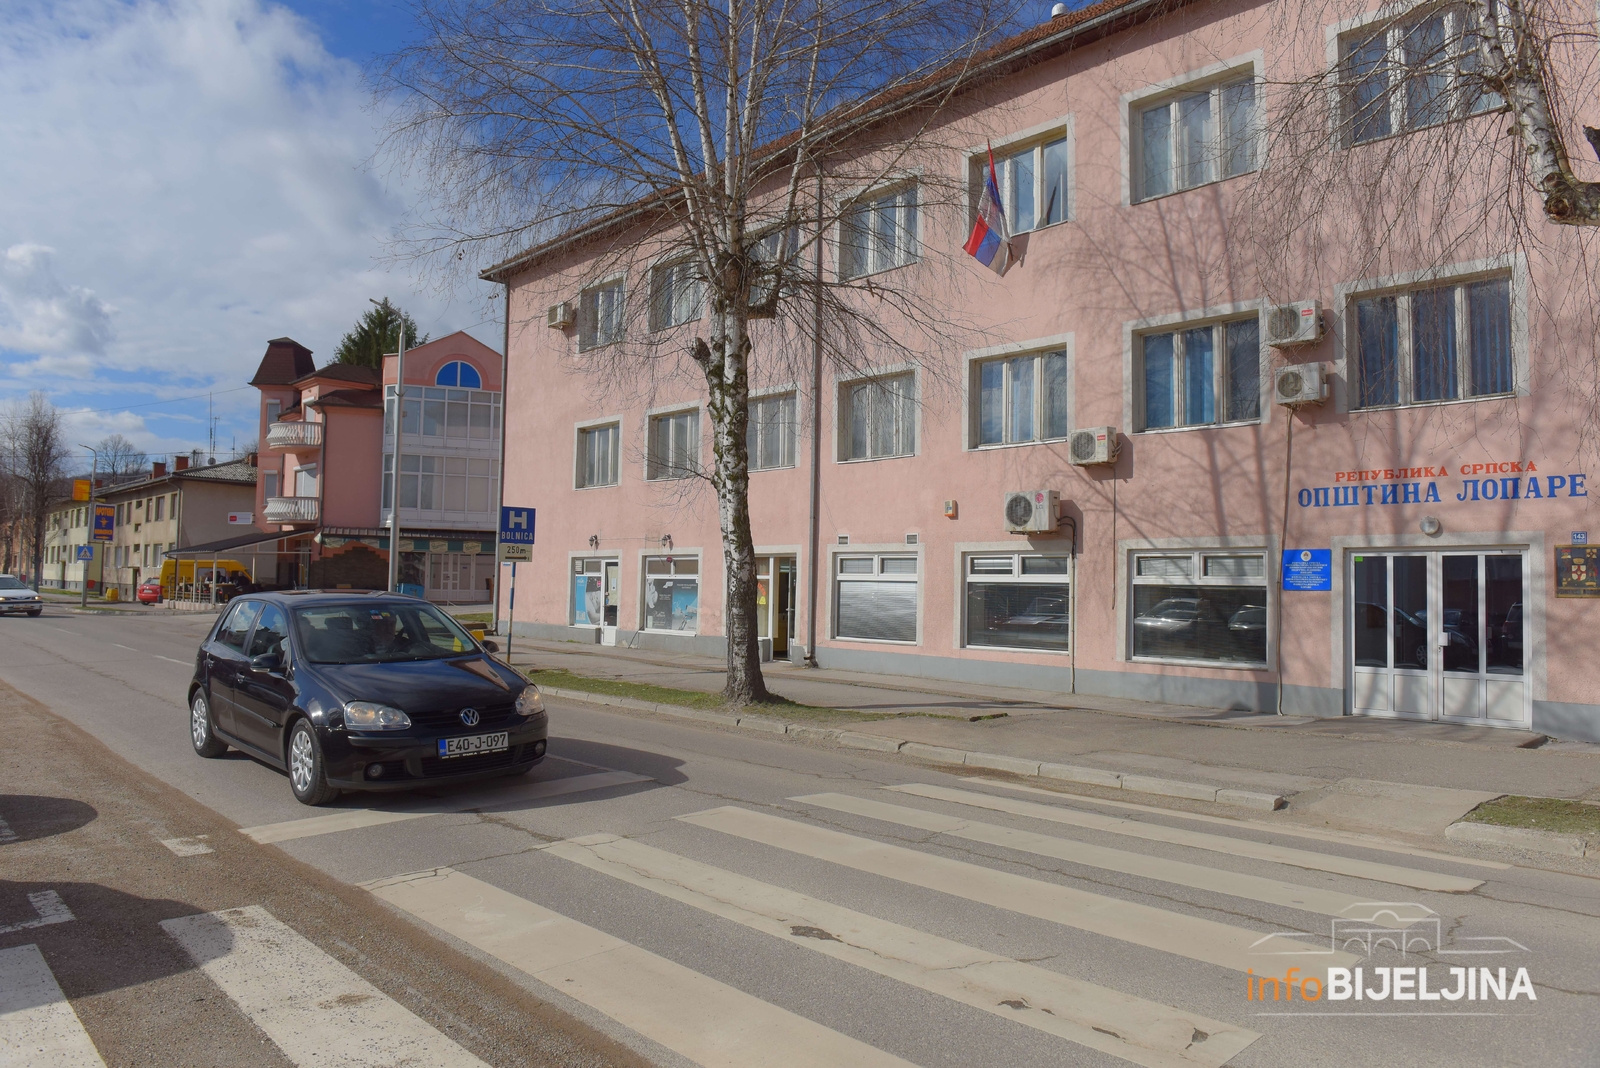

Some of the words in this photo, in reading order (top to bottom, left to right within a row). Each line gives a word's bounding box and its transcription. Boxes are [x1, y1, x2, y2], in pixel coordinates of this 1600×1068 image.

[1335, 466, 1449, 482] РЕПУБЛИКА
[1460, 460, 1538, 476] СРПСКА
[1298, 481, 1442, 507] ОПШТИНА
[1456, 473, 1588, 502] ЛОПАРЕ
[509, 510, 528, 530] H
[501, 531, 534, 541] BOLNICA
[447, 733, 507, 753] E40-J-097
